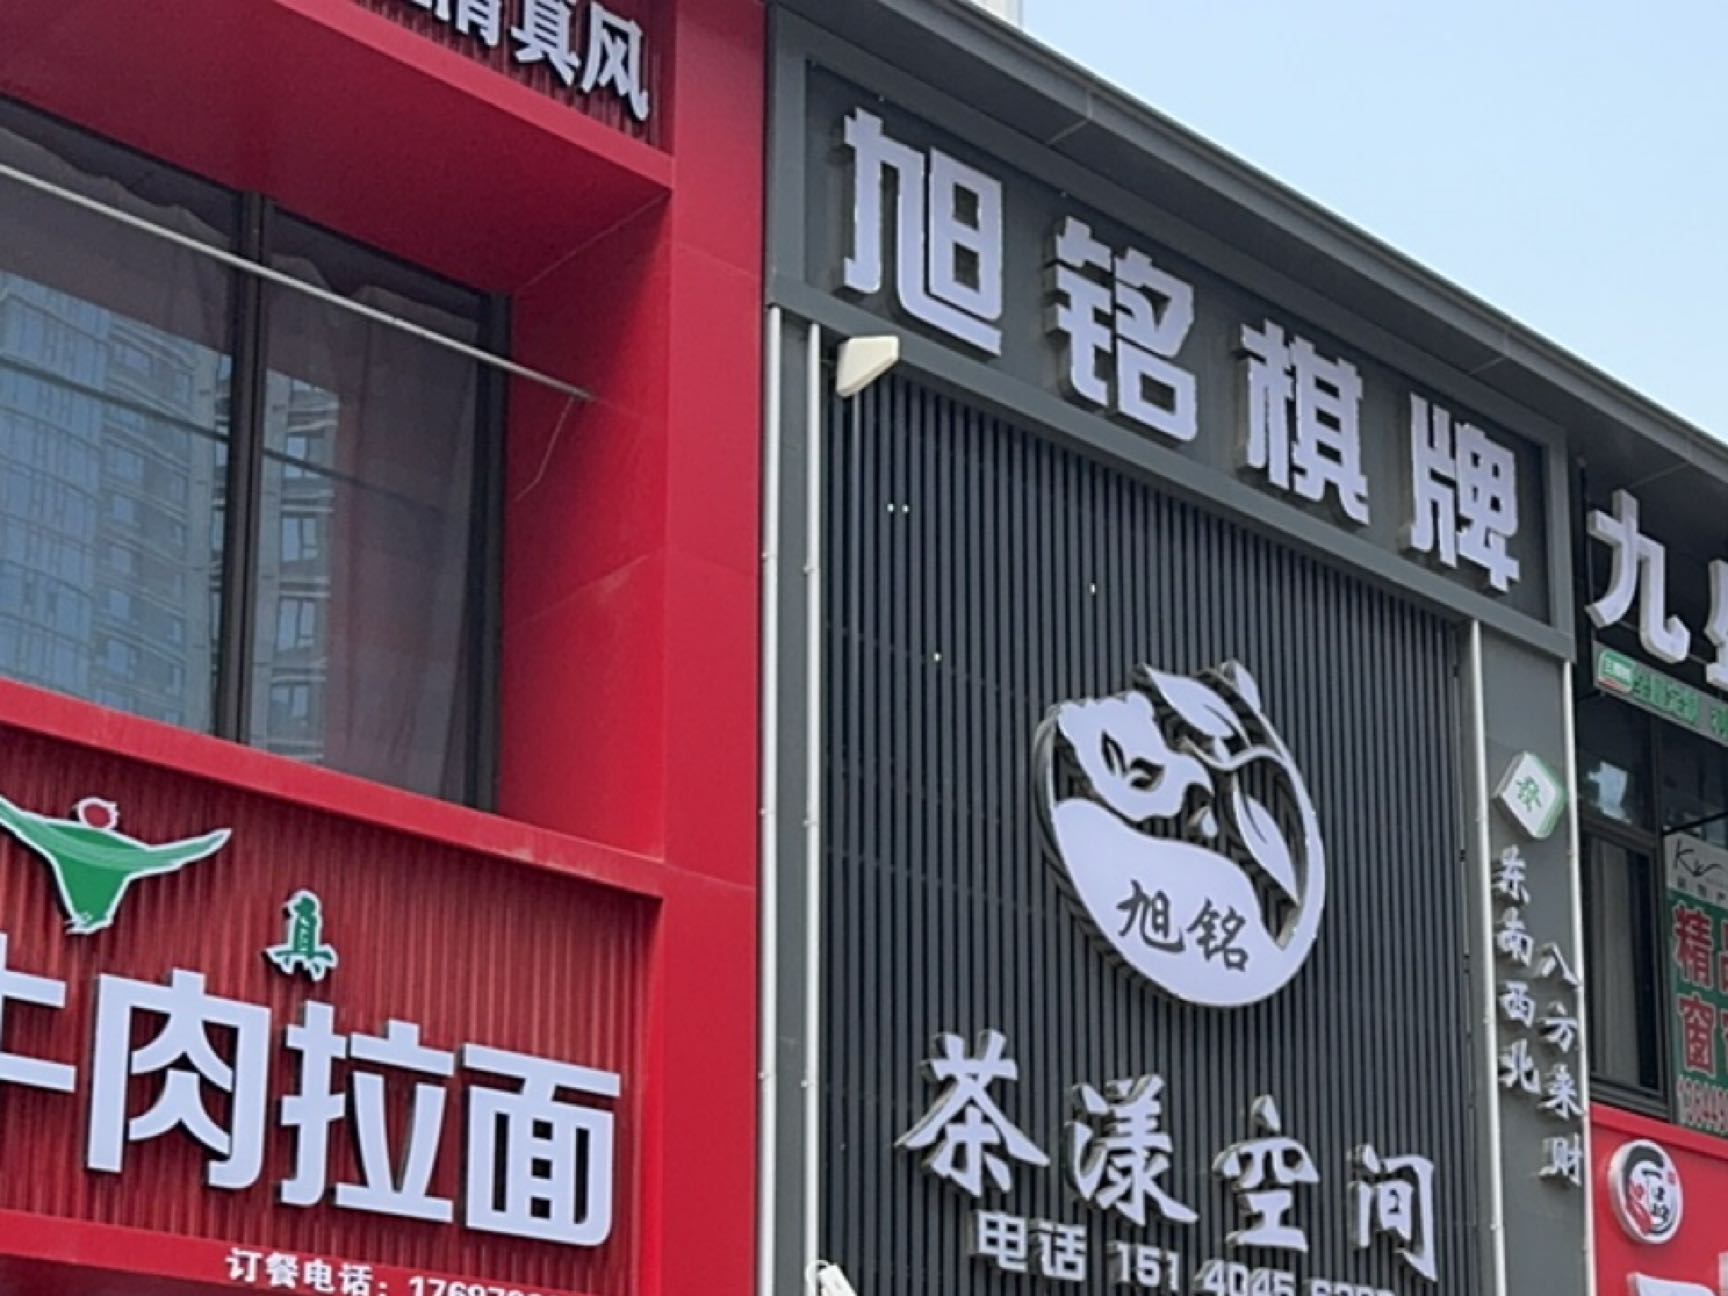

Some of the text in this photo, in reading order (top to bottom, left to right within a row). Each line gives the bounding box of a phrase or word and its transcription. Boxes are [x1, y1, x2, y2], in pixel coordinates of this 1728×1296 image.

[403, 0, 649, 121] 真风
[842, 106, 1520, 594] 旭铭棋牌
[1117, 880, 1250, 973] 旭铭
[1495, 844, 1540, 1095] 东南西北
[896, 1029, 1439, 1284] 茶漾空间
[1538, 943, 1584, 1189] 八方来财
[971, 1211, 1087, 1283] 电话
[1113, 1241, 1181, 1293] 151
